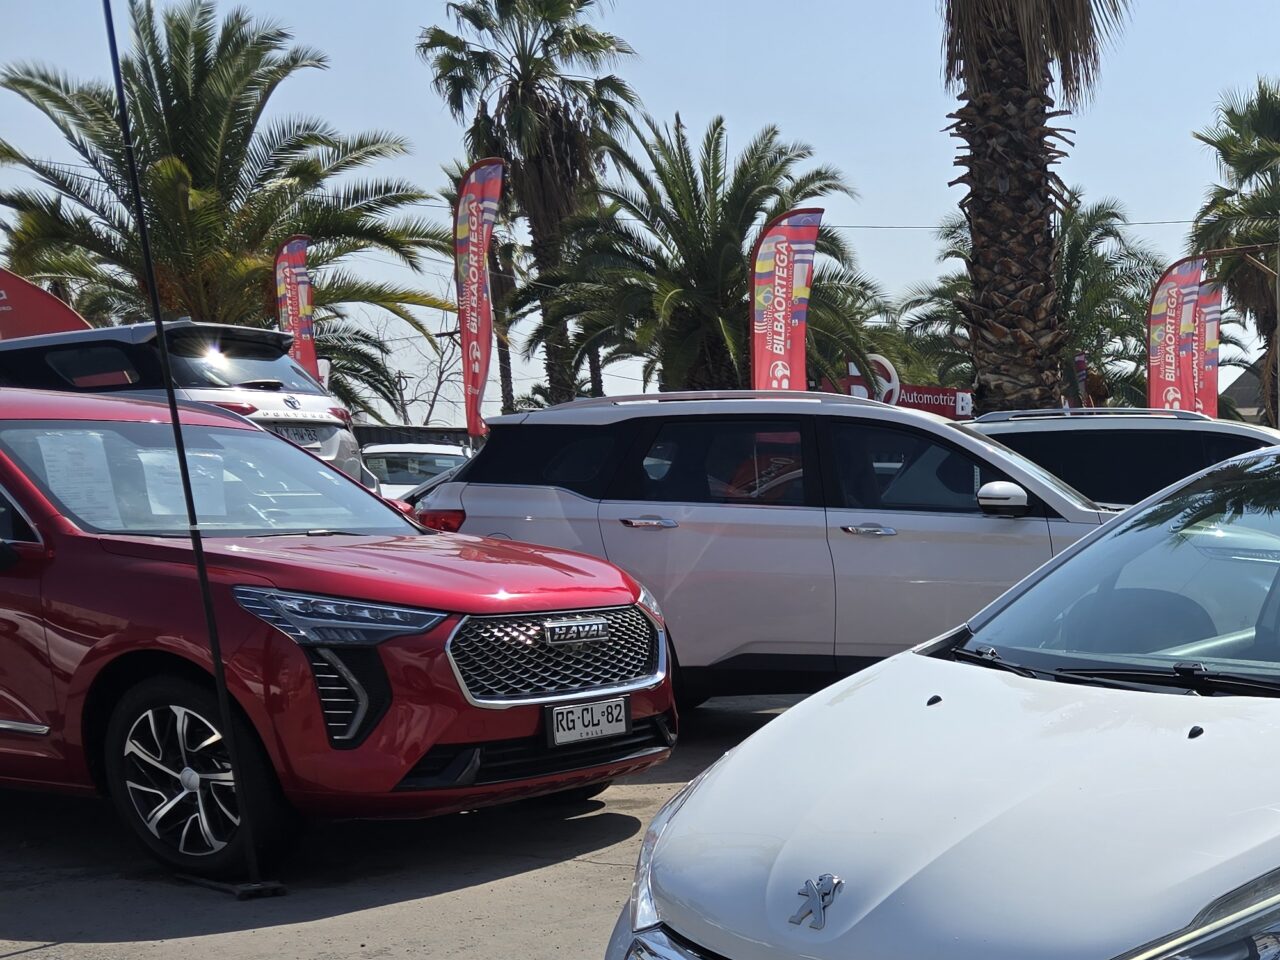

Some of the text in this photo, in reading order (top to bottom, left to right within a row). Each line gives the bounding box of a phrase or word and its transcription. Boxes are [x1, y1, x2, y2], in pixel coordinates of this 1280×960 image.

[469, 201, 479, 334] BILBAORTEGA
[773, 242, 788, 355] BILBAORTEGA
[765, 304, 773, 351] Automotriz
[1165, 287, 1178, 382] BILBAORTEGA
[900, 389, 956, 406] Automotriz
[553, 624, 607, 640] HAVAL
